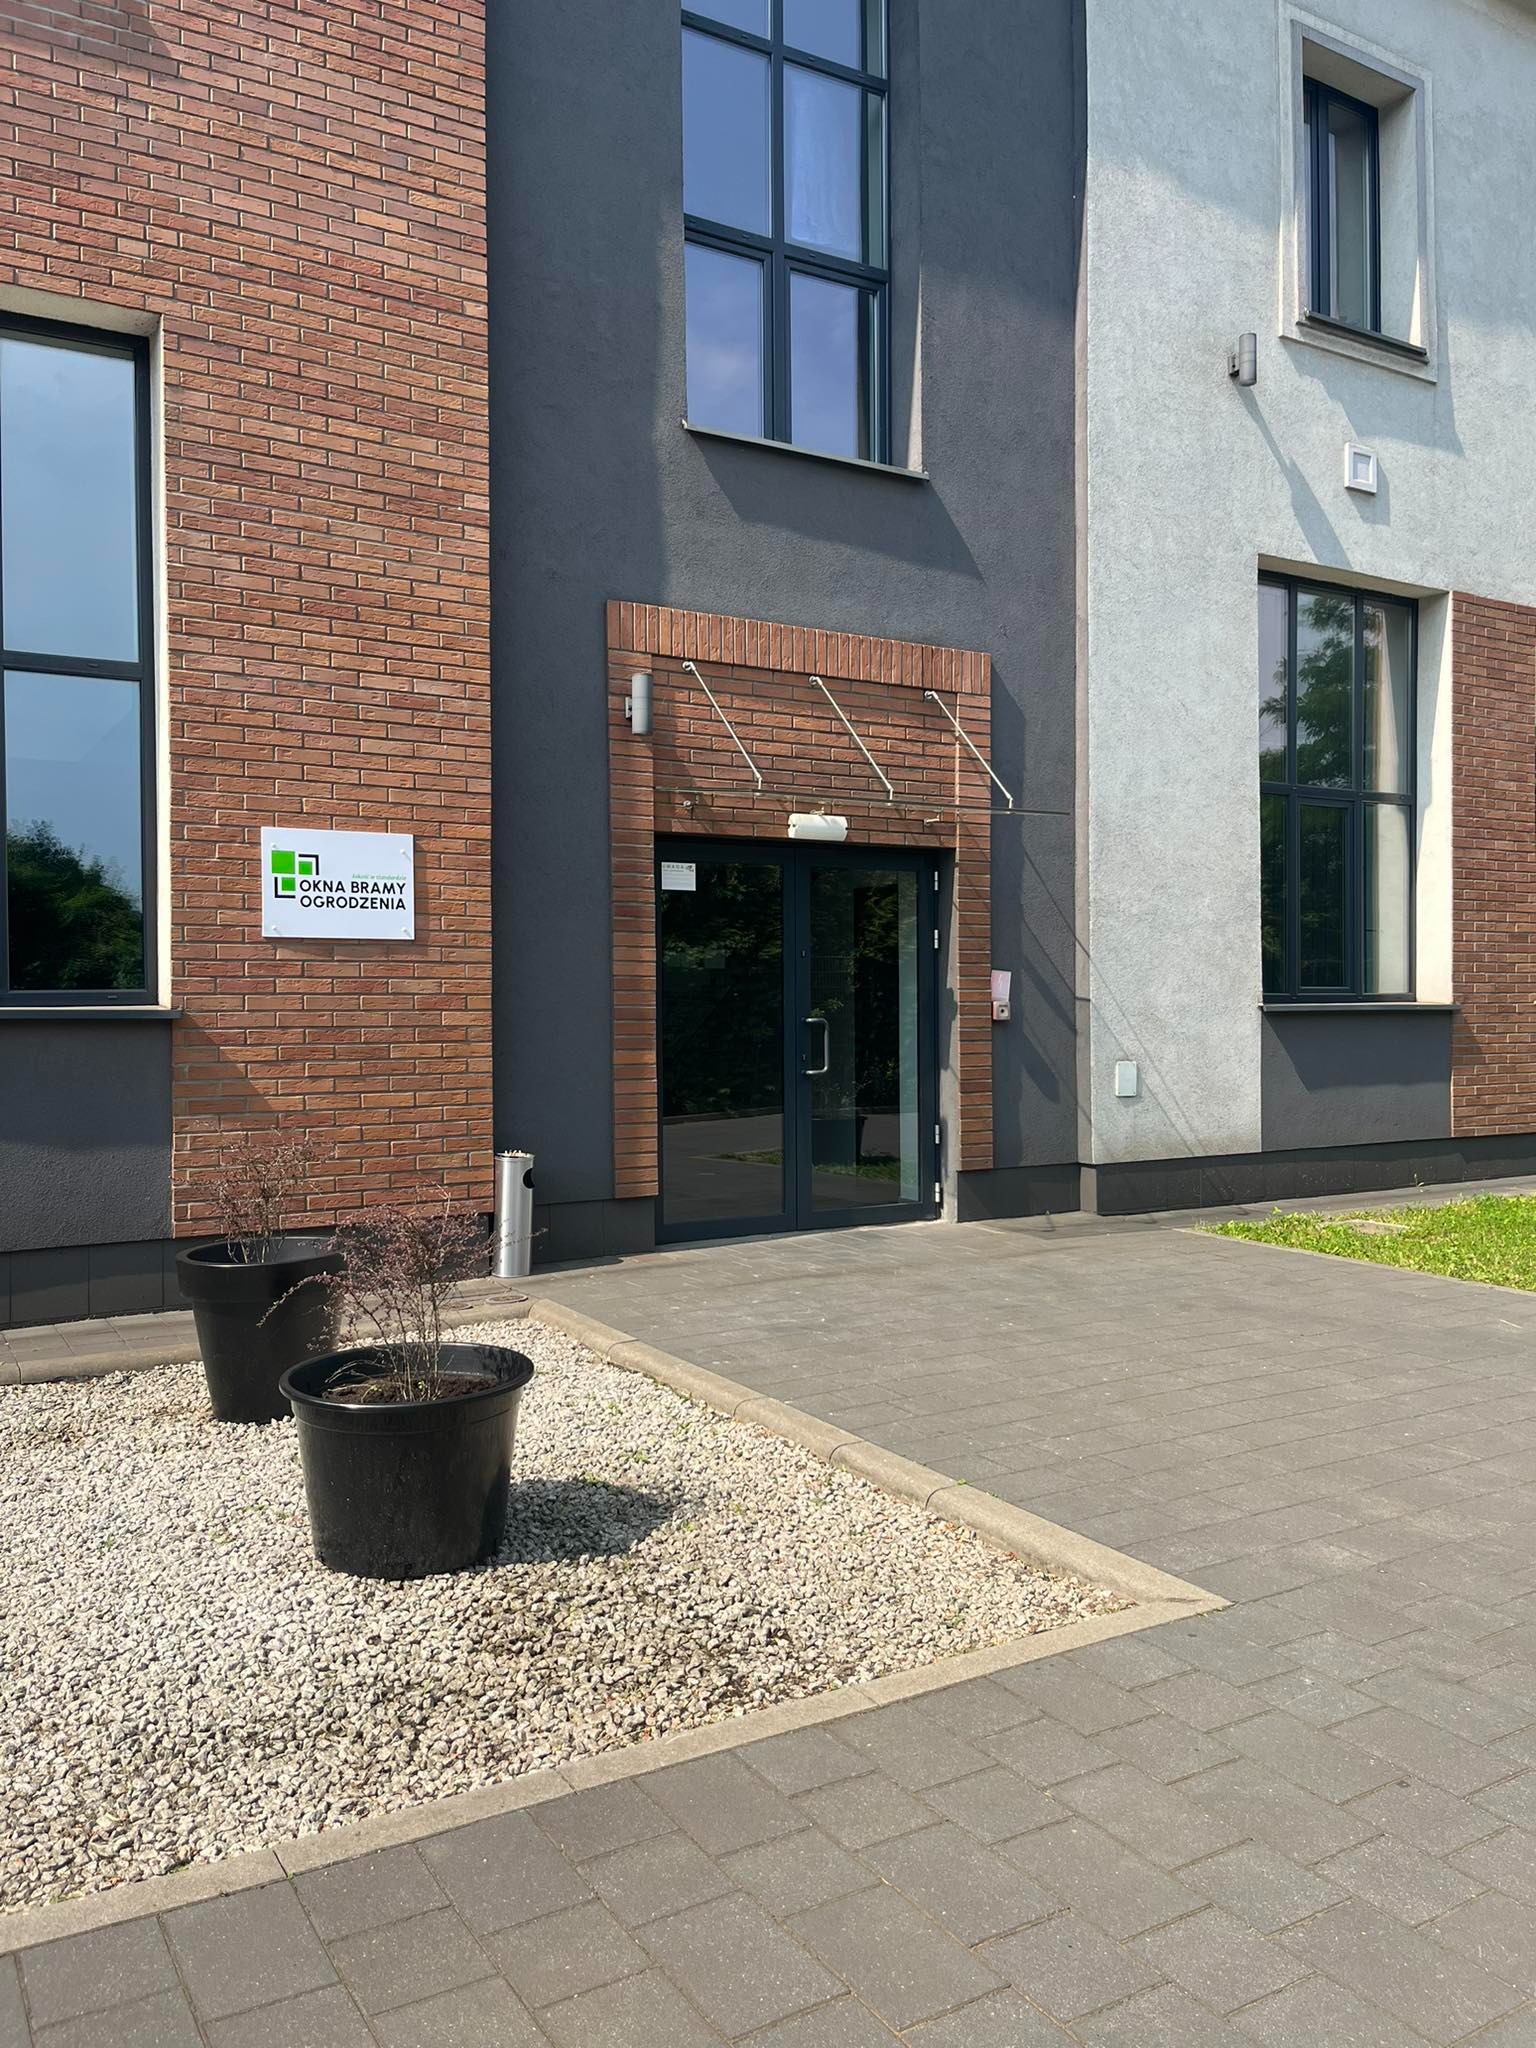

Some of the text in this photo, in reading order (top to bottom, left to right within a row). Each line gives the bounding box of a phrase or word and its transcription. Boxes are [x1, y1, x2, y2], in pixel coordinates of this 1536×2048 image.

[299, 879, 407, 895] OKNA BRAMY
[300, 895, 407, 910] OGRODZENIA
